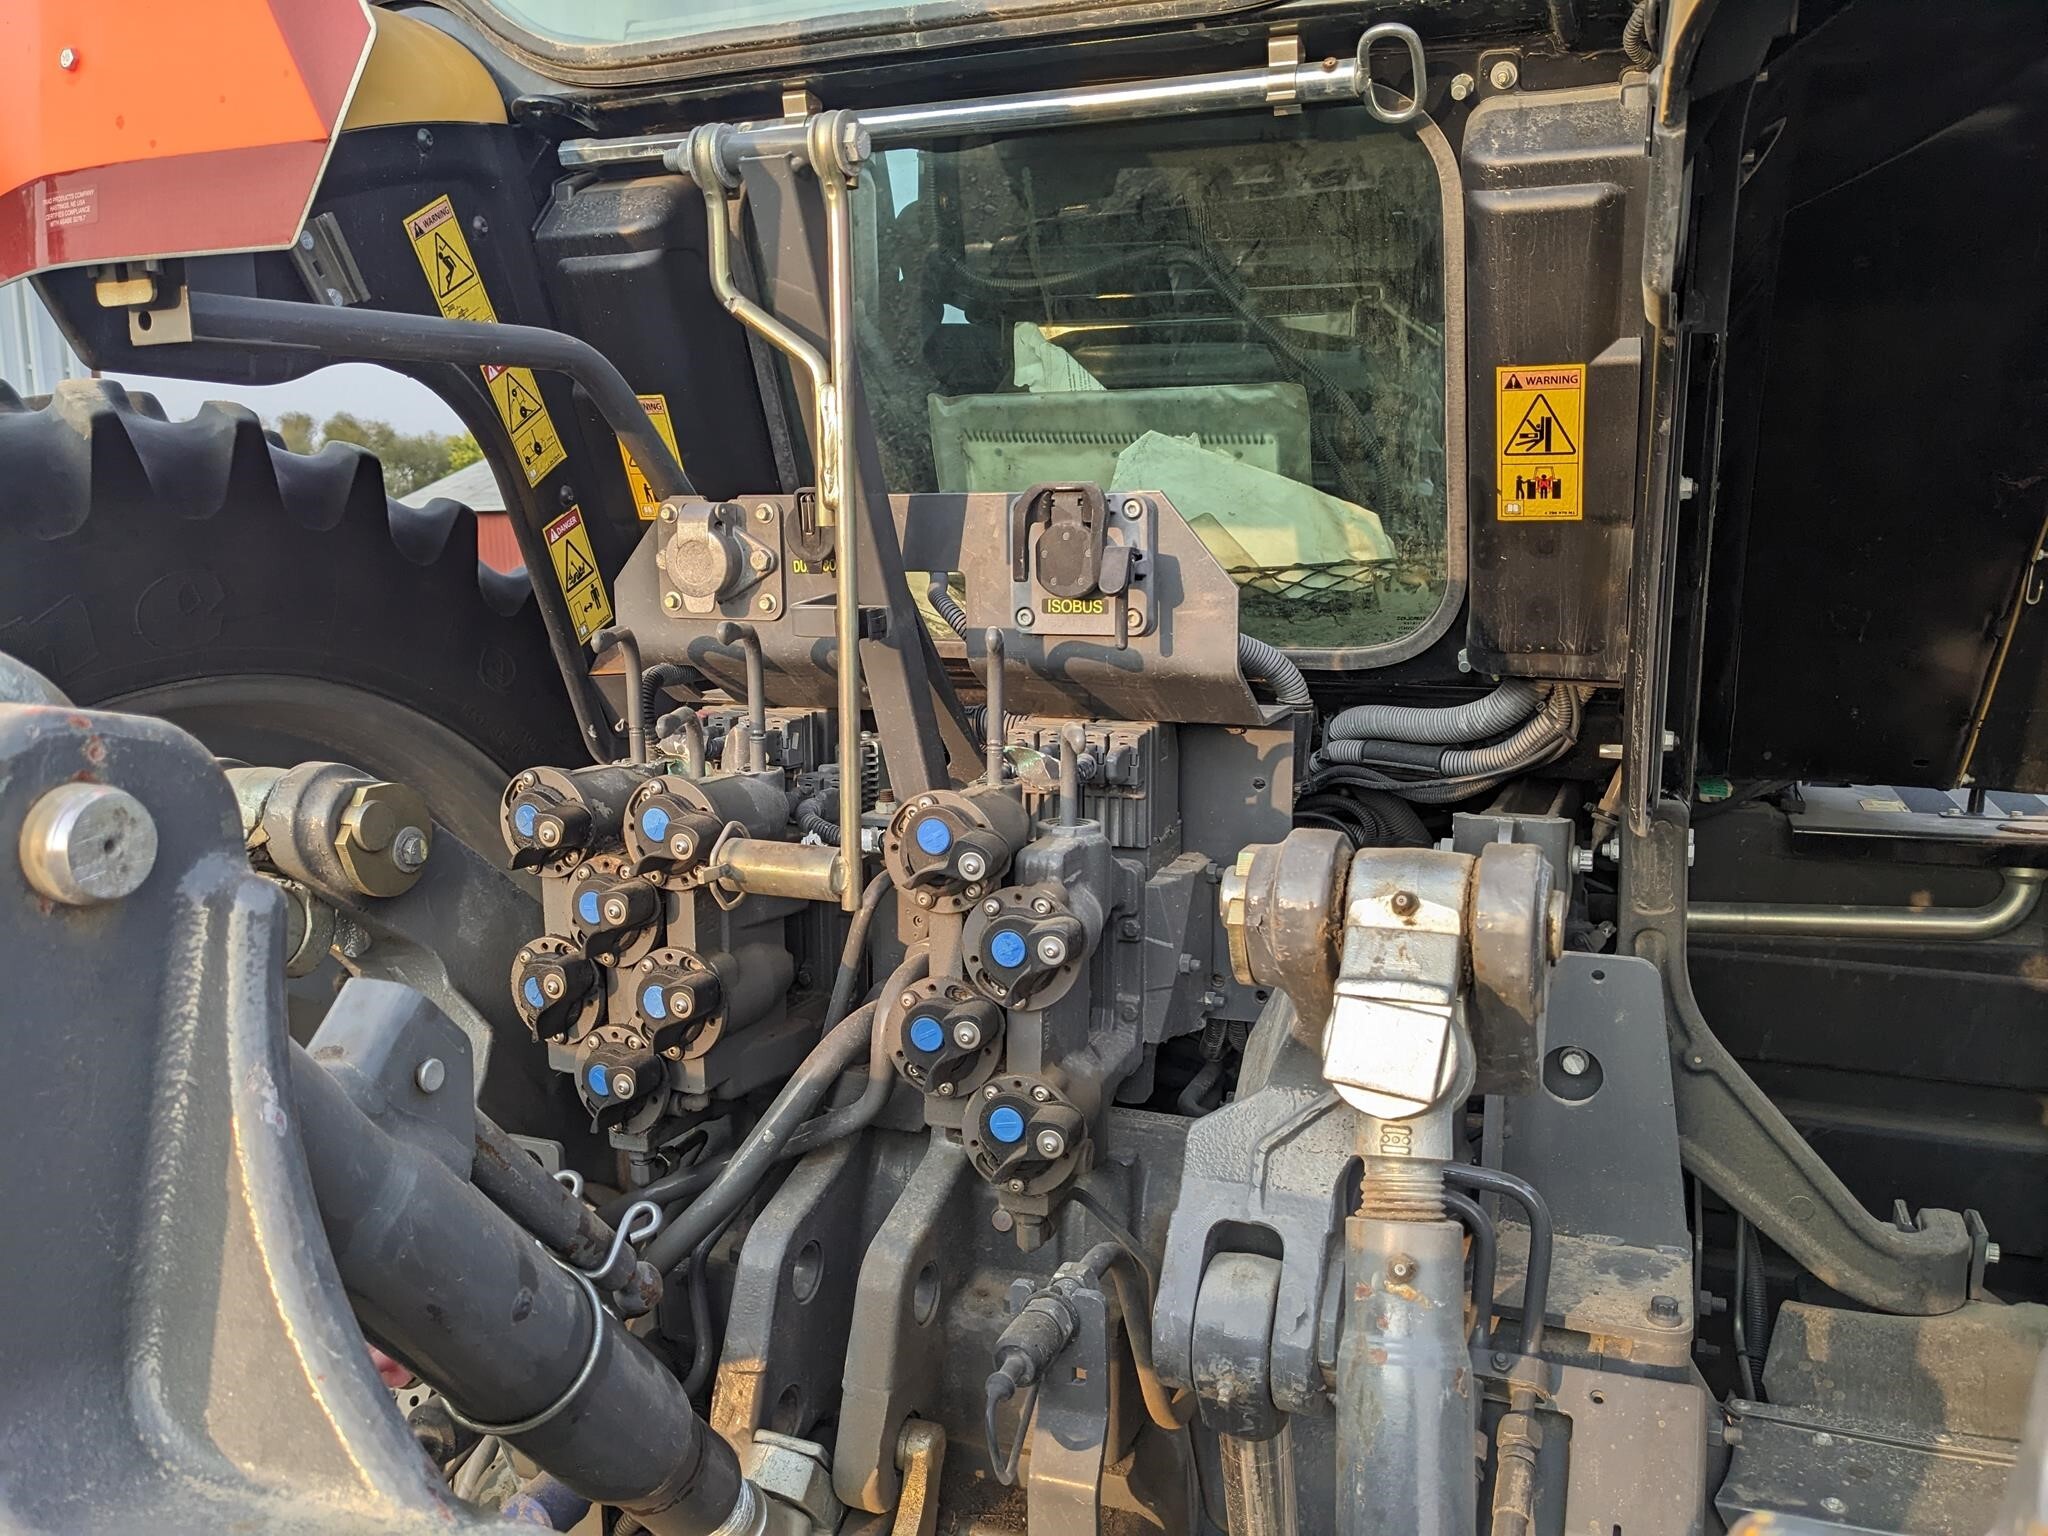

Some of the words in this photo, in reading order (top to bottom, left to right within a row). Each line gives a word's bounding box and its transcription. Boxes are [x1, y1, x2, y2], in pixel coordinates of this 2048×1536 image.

[422, 206, 450, 228] WARNING
[1525, 374, 1579, 386] WARNING
[556, 515, 577, 535] DANGER
[1047, 599, 1103, 614] ISOBUS
